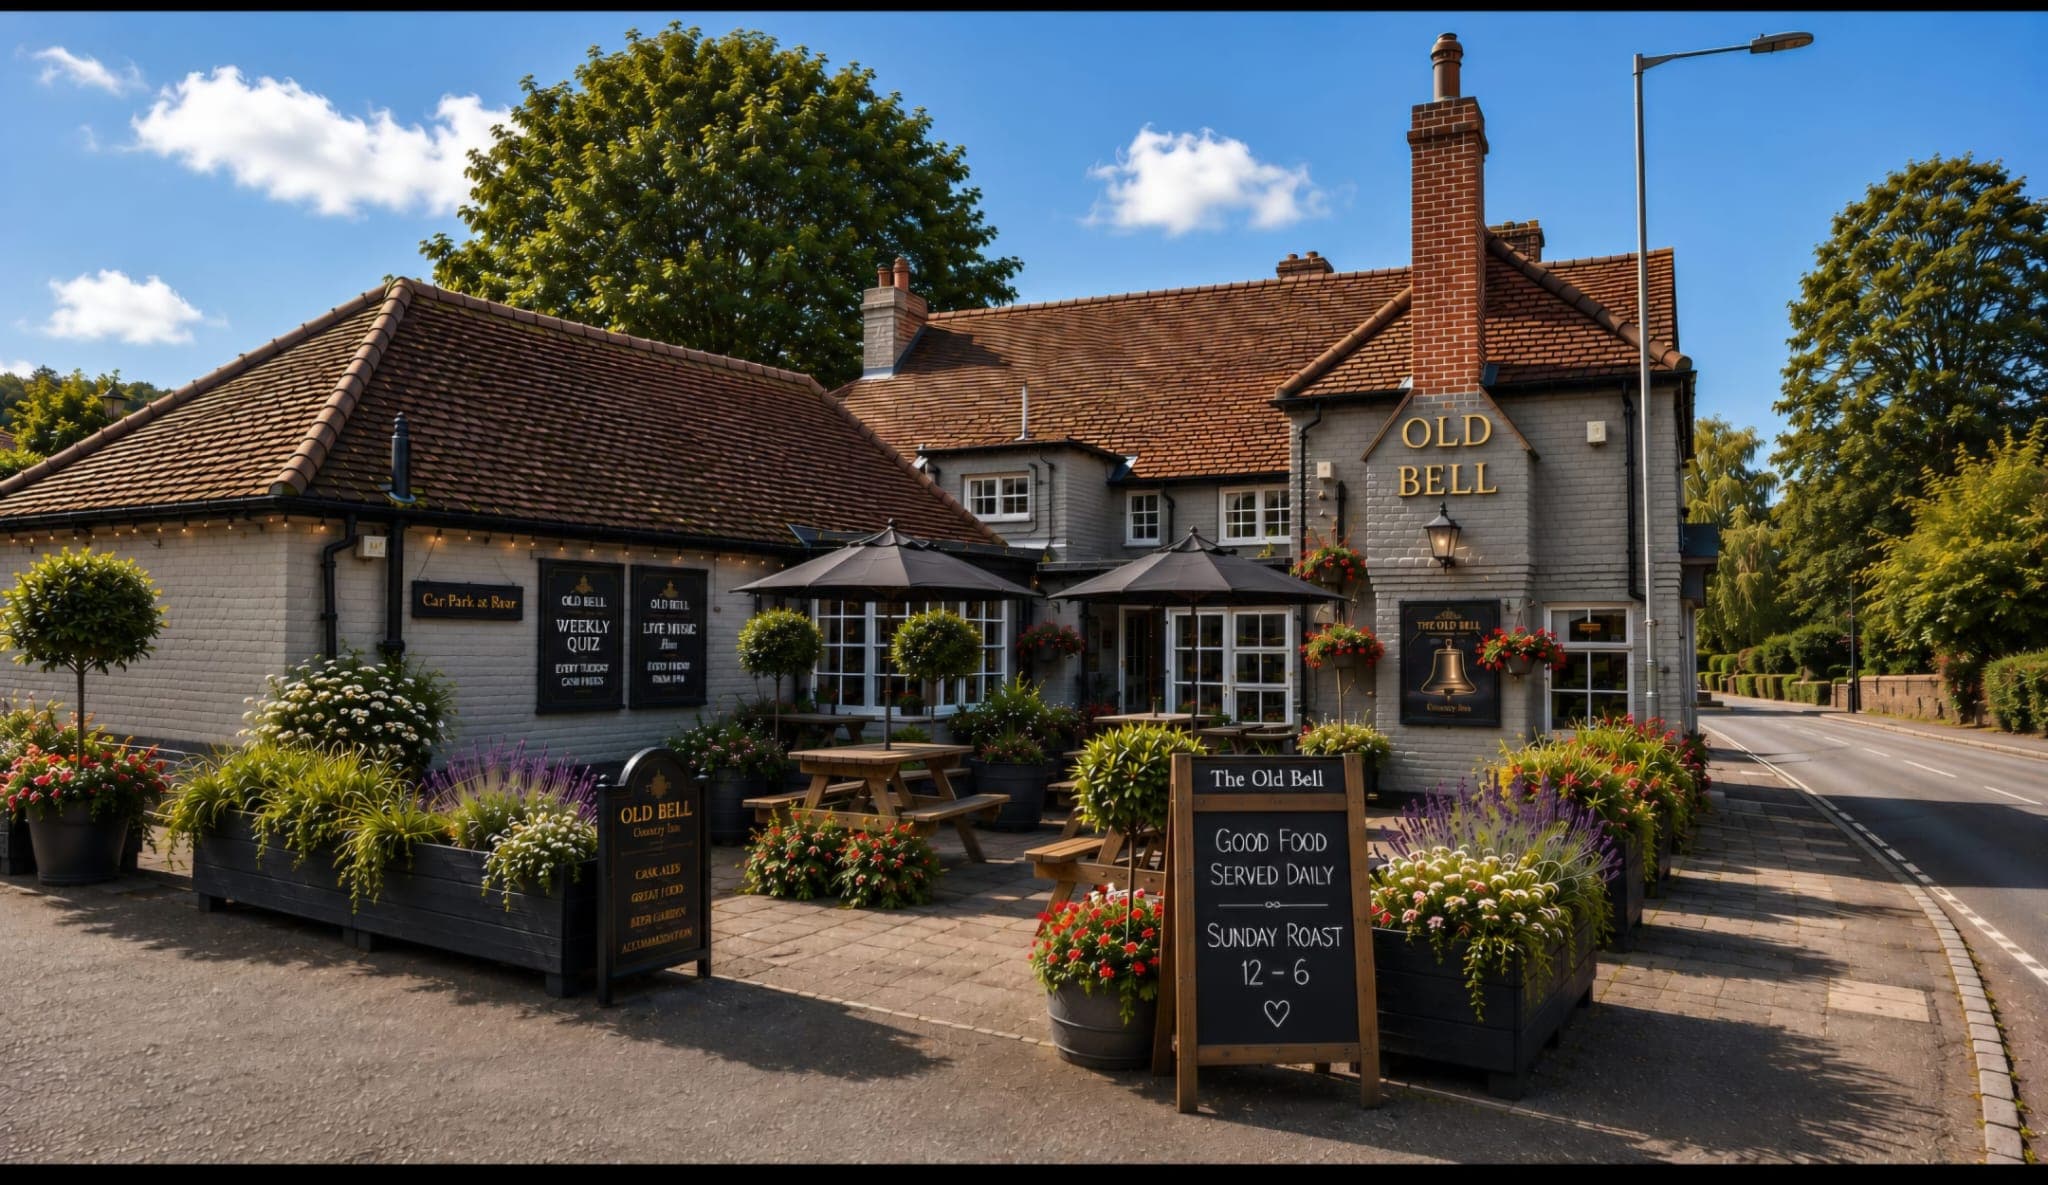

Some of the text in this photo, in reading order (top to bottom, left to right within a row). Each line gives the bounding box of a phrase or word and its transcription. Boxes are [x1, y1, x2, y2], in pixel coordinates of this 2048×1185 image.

[1402, 413, 1492, 449] OLD
[1397, 462, 1497, 497] BELL
[423, 592, 446, 608] Car
[448, 594, 474, 607] Park
[561, 595, 581, 607] OLD
[650, 599, 668, 610] OLD
[556, 619, 610, 633] WEEKLY
[1436, 620, 1457, 631] OLD
[567, 636, 600, 653] QUIZ
[1210, 769, 1324, 787] The Old Bell
[620, 800, 693, 824] OLD BELL
[1215, 828, 1327, 853] GOOD FOOD
[1211, 862, 1334, 886] SERVED DAILY
[1207, 922, 1343, 948] SUNDAY ROAST
[1241, 959, 1264, 986] 12
[1294, 958, 1310, 985] 6
